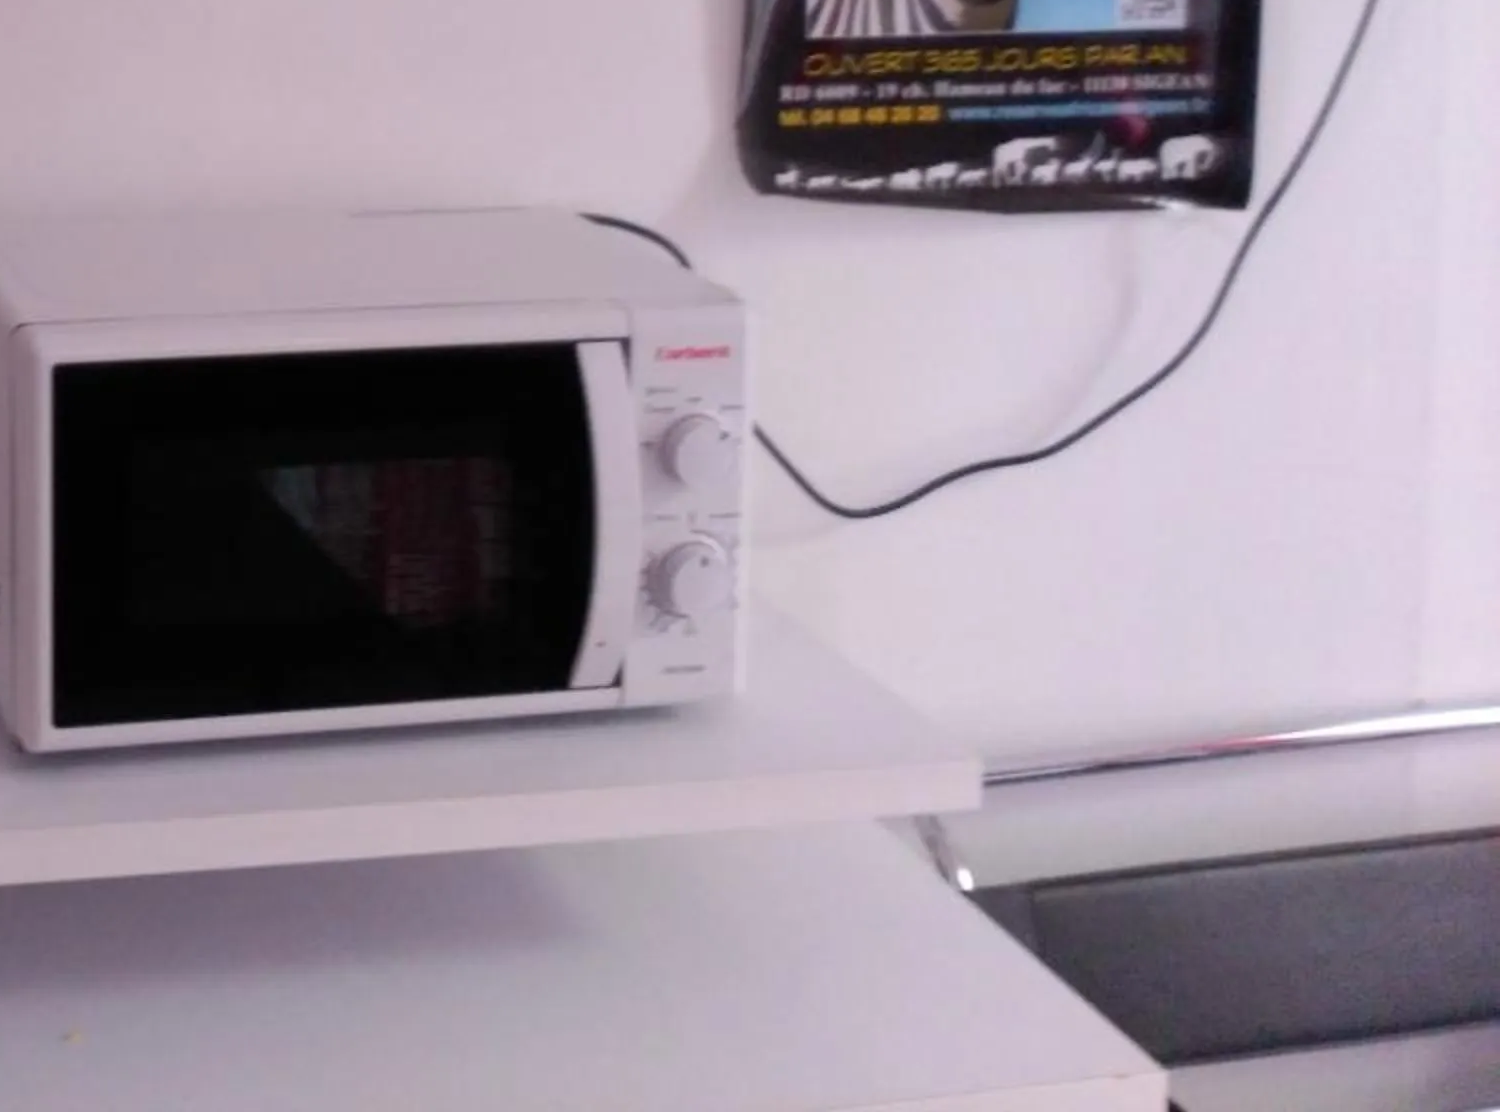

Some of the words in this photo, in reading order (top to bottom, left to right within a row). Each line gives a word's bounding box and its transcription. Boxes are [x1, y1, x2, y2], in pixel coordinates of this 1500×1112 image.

[803, 49, 921, 76] OUVERT
[922, 48, 981, 74] 365
[983, 46, 1077, 72] JOURS
